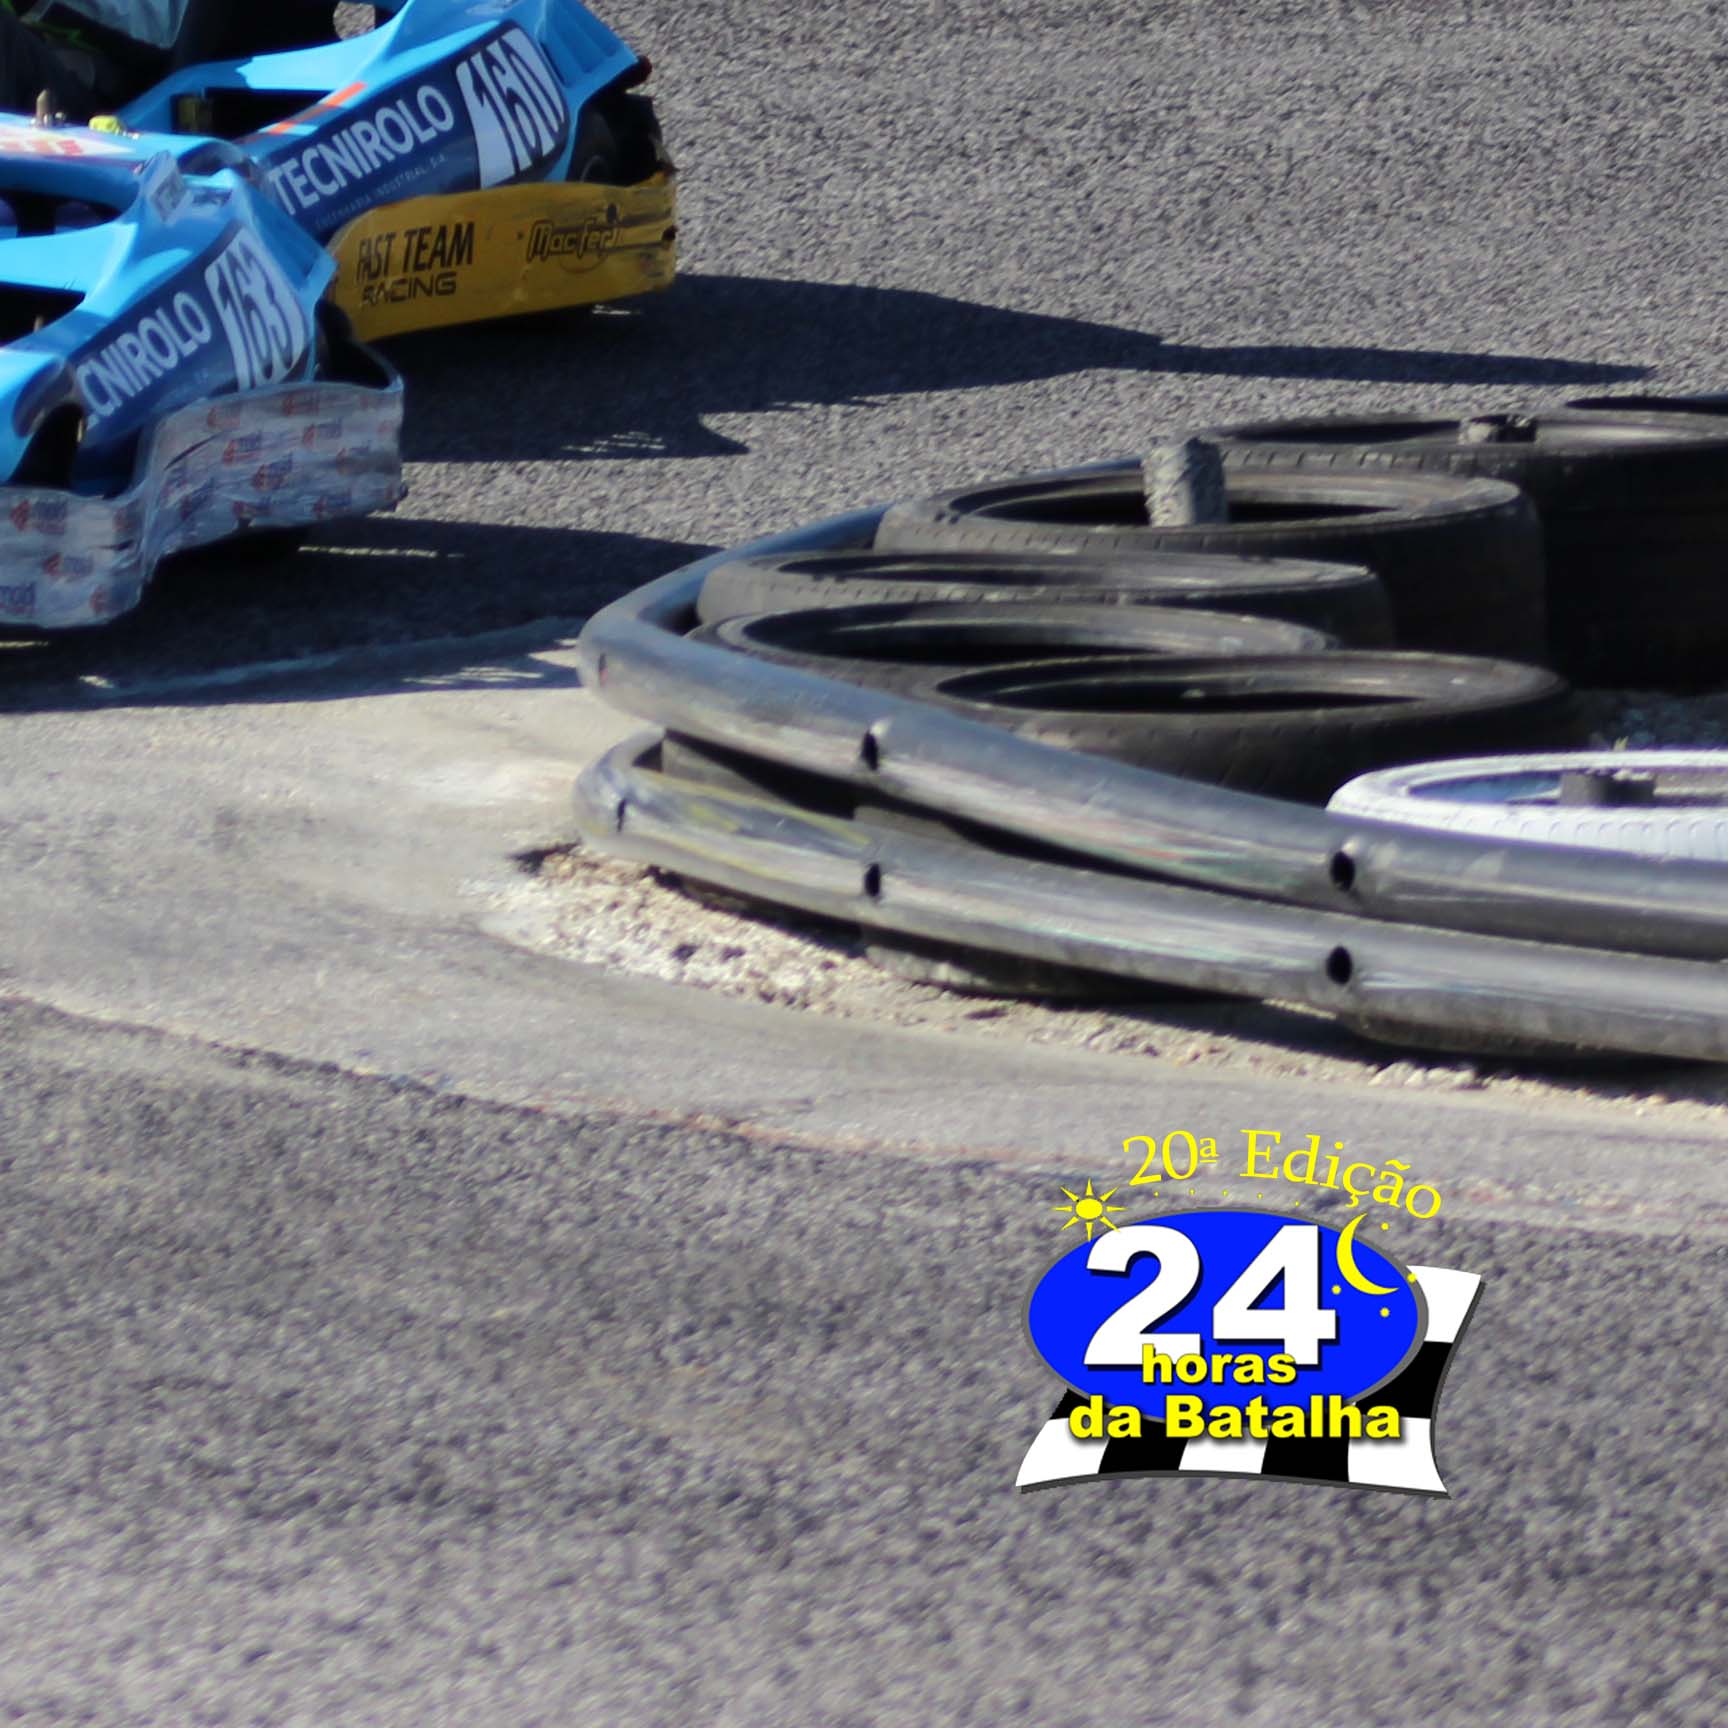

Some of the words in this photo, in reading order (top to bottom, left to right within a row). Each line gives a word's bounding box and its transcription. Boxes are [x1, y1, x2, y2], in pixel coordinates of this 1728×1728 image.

[268, 85, 454, 216] TECNIROLO
[357, 229, 398, 284] FAST
[404, 221, 475, 273] TEAM
[362, 272, 457, 307] RACING
